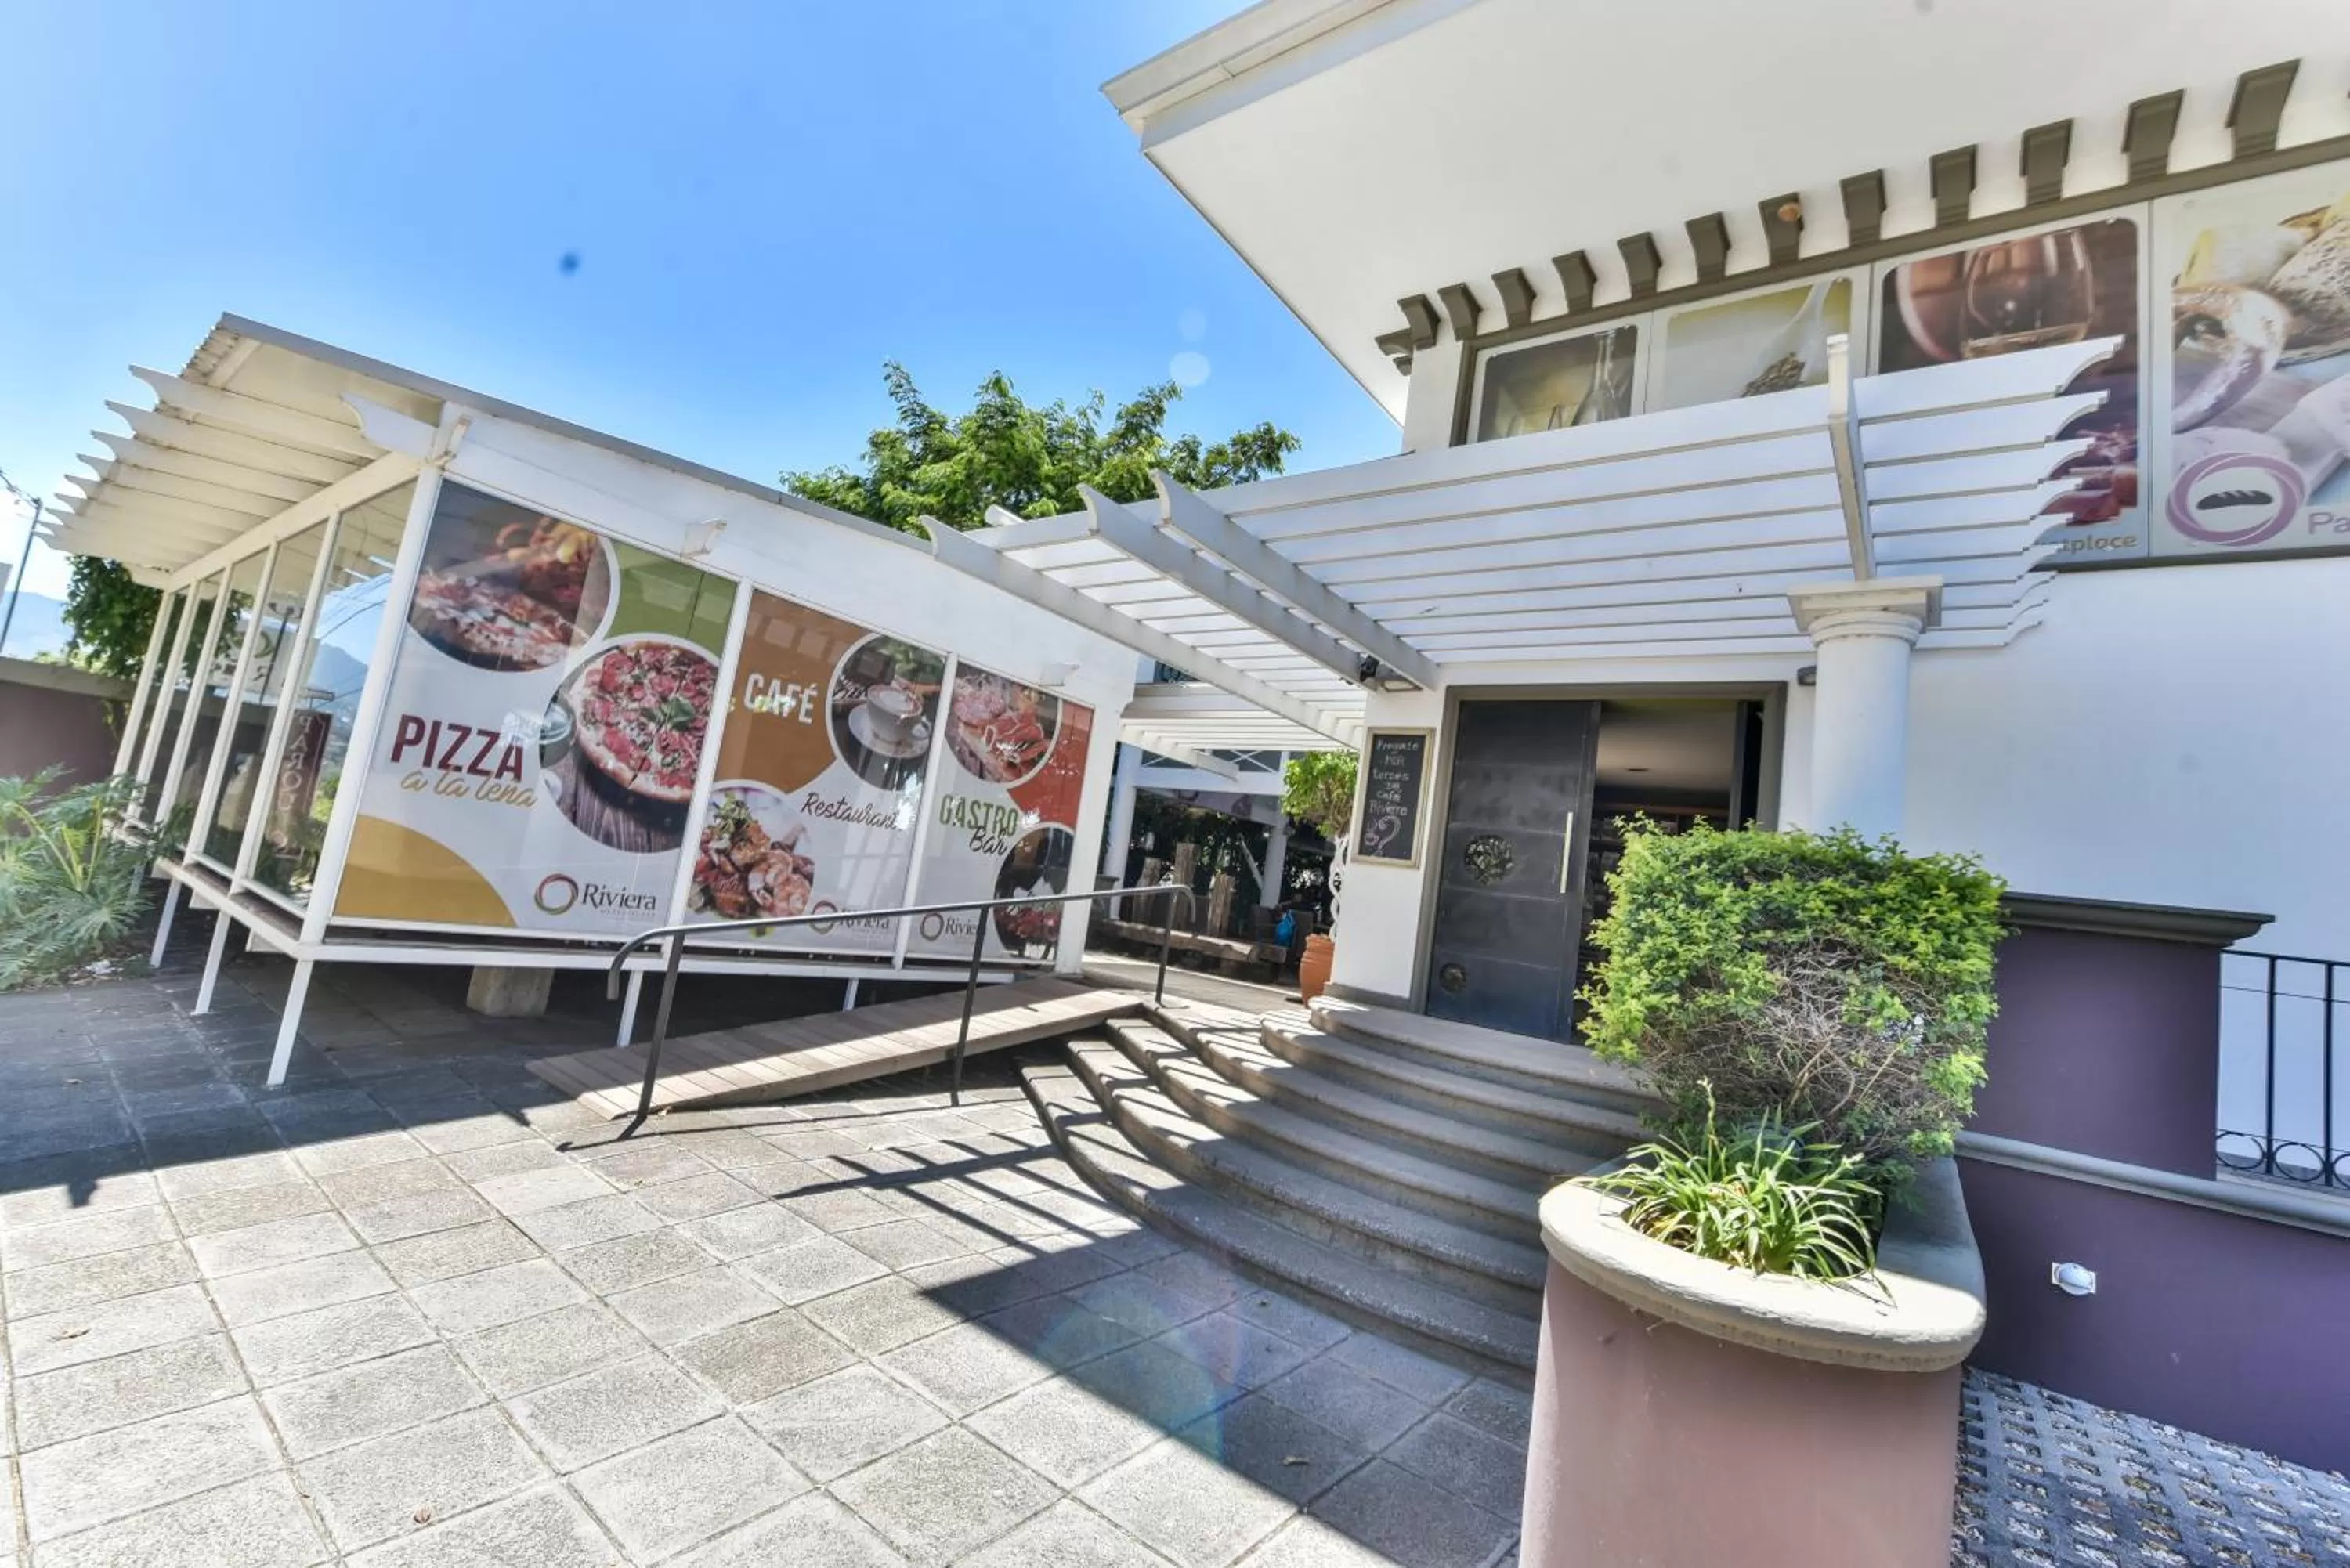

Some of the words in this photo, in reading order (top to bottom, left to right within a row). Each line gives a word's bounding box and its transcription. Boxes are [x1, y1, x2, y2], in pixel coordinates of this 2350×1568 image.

[743, 673, 818, 725] CAFÉ
[390, 714, 524, 783] PIZZA
[400, 770, 429, 792] a
[433, 767, 471, 797] la
[939, 794, 1018, 837] GASTRO
[969, 825, 1007, 856] Bar
[581, 883, 657, 911] Riviera
